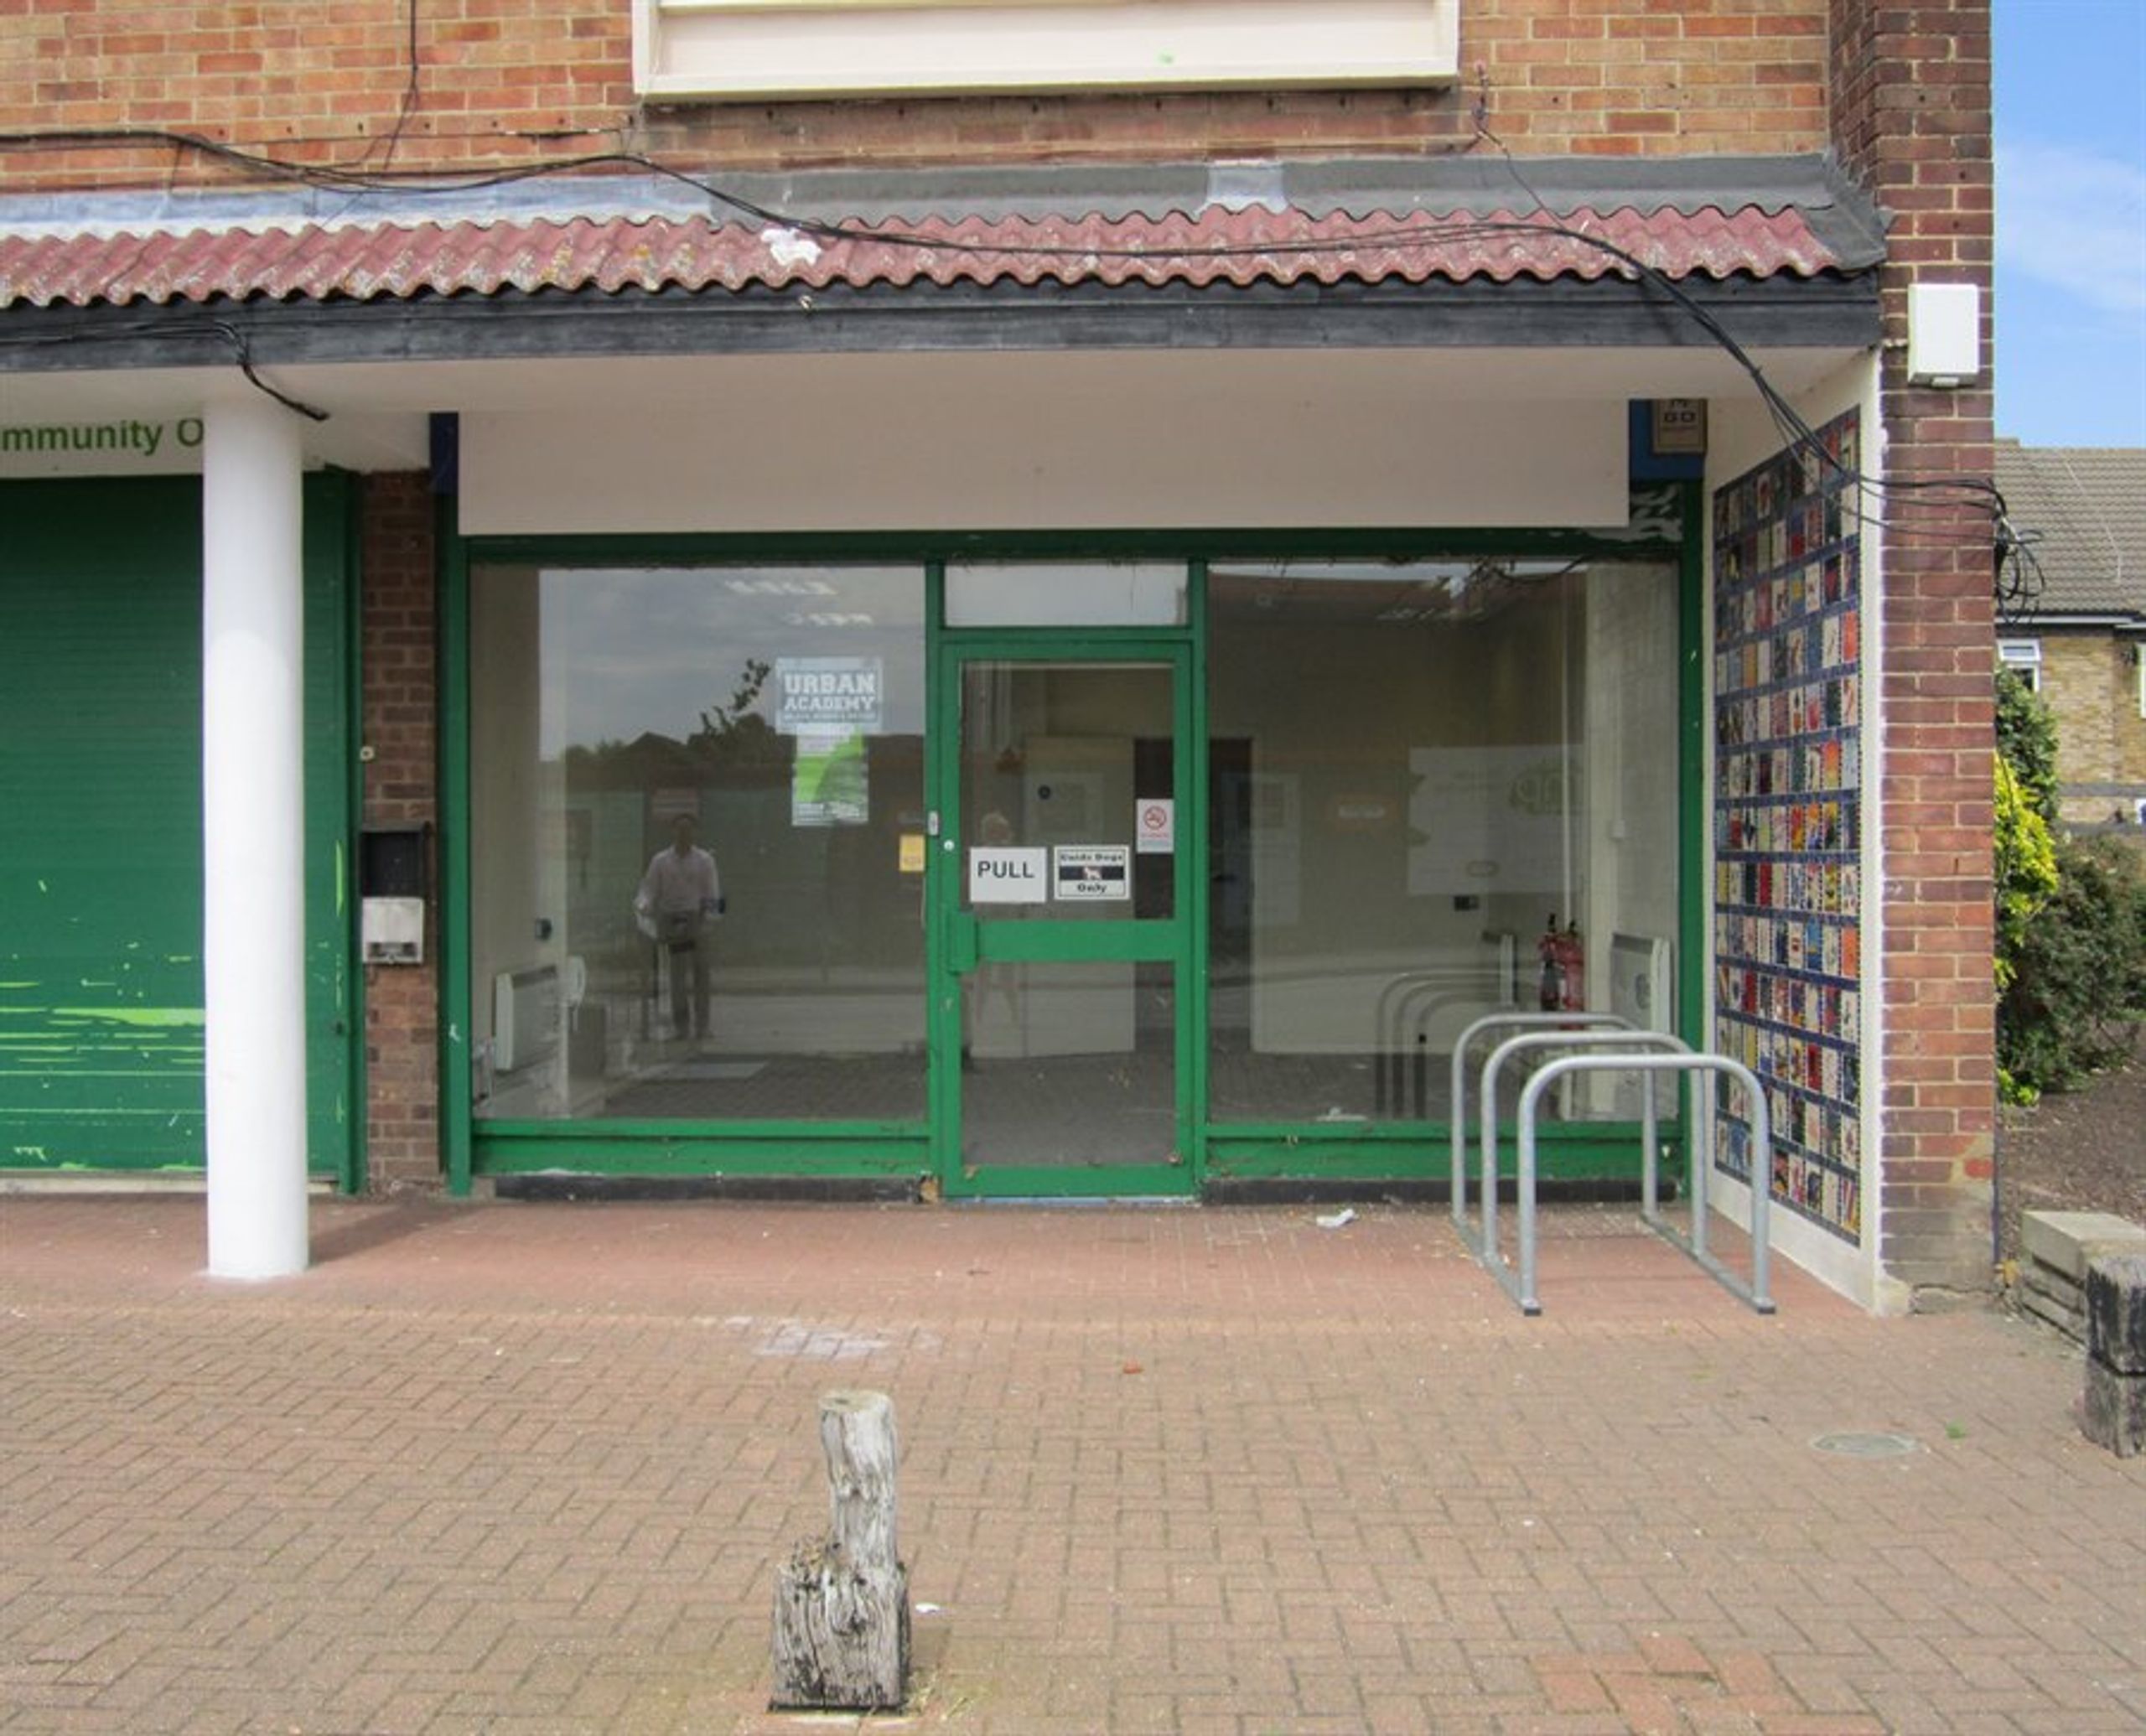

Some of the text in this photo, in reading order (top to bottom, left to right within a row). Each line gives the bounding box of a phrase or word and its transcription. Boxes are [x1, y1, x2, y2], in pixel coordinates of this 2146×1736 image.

[3, 418, 204, 456] mmunity O
[784, 673, 875, 694] URBAN
[784, 697, 875, 711] ACADEMY
[1095, 853, 1122, 862] Dogs
[977, 861, 1034, 878] PULL
[1077, 882, 1107, 893] Only
